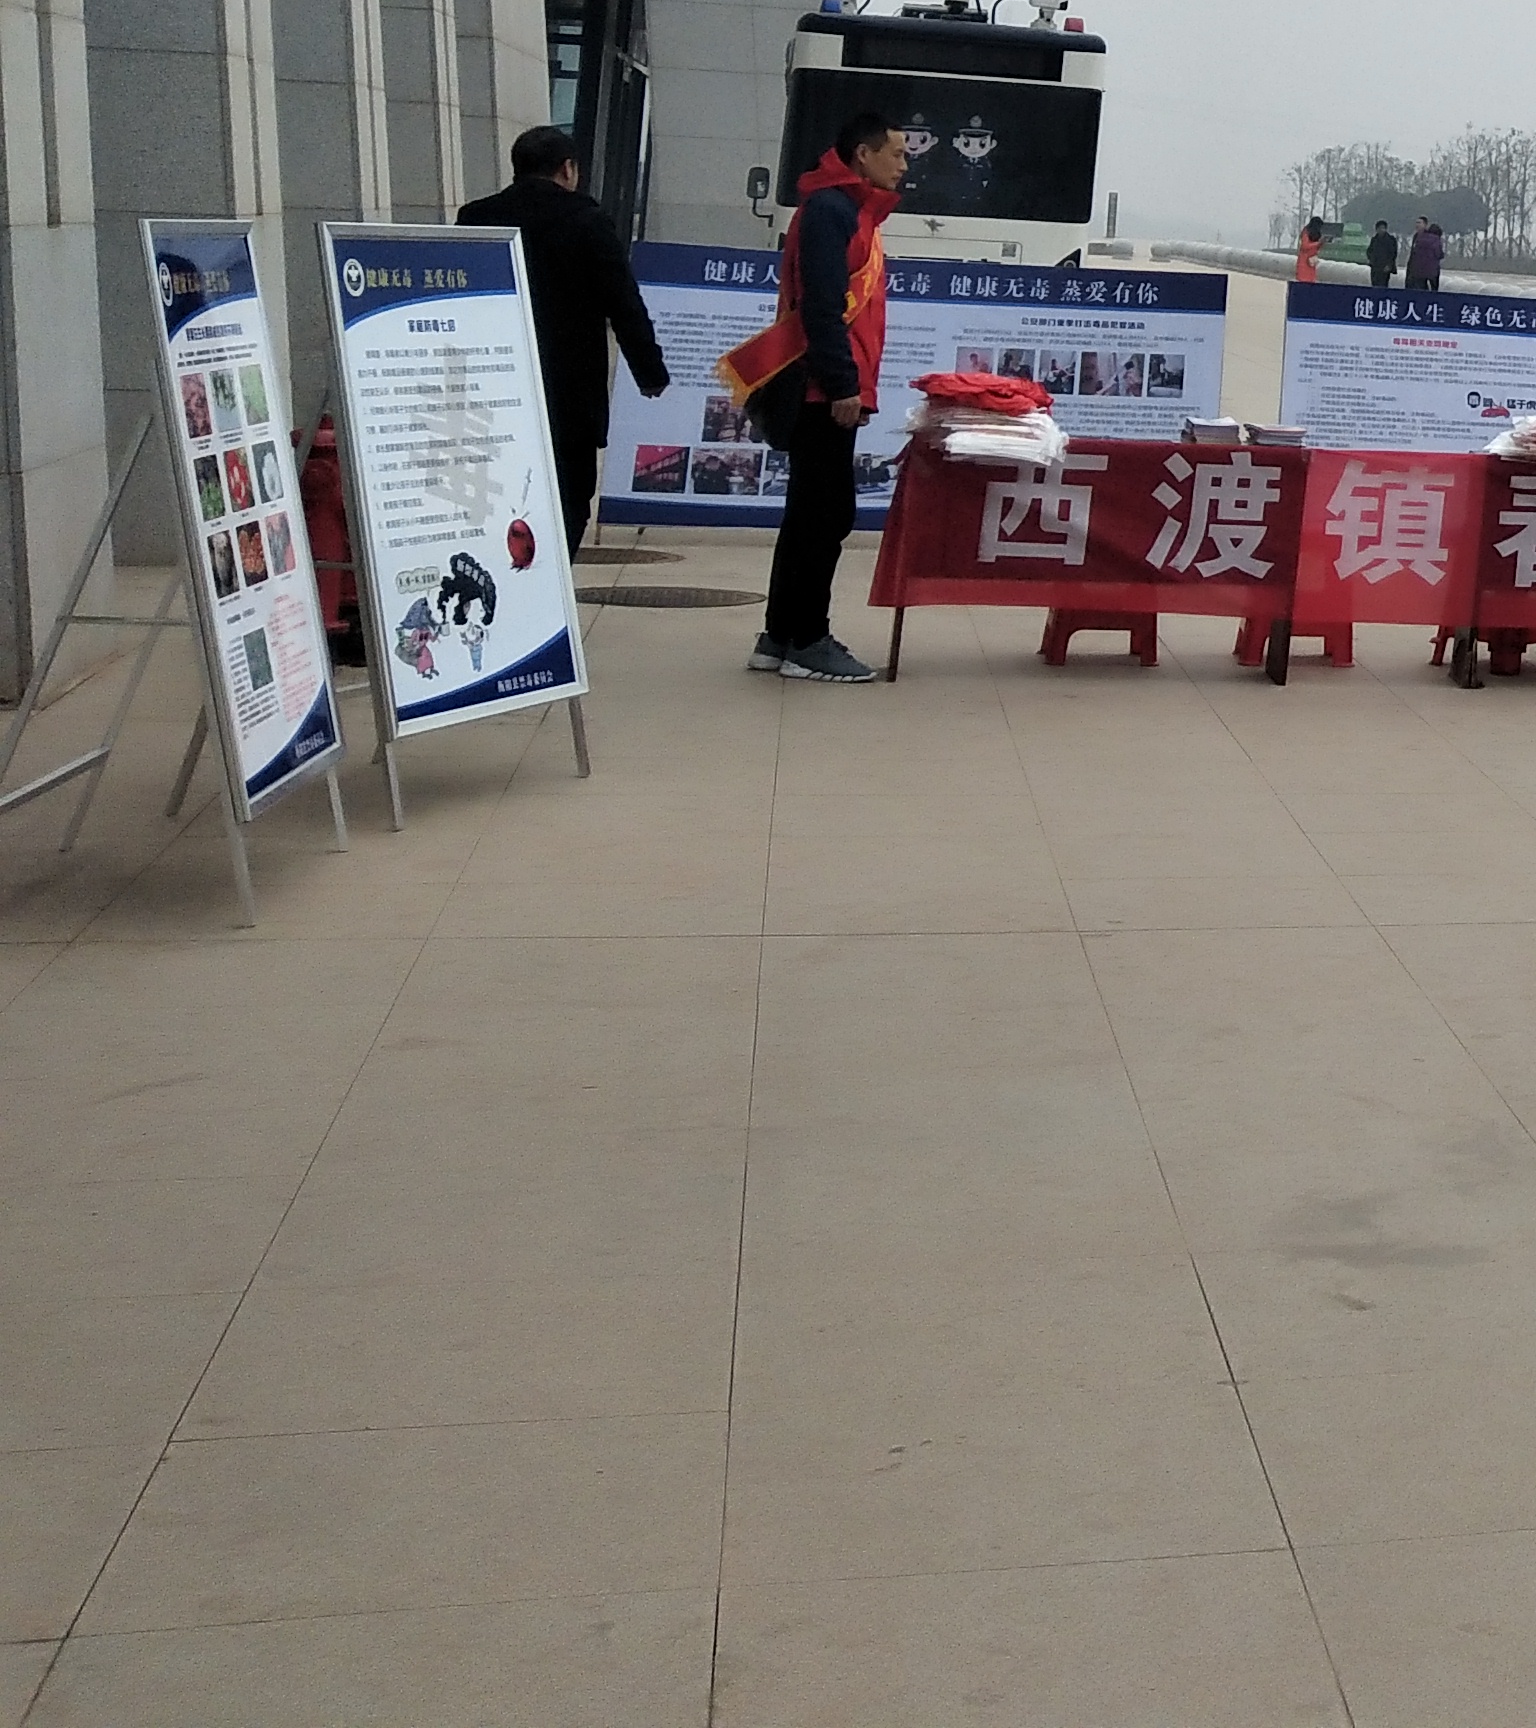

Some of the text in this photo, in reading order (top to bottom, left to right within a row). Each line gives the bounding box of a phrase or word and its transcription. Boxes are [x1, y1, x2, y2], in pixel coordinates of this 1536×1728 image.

[366, 268, 413, 289] 健康无毒
[704, 259, 781, 284] 健康人
[950, 274, 1050, 301] 健康无毒
[1060, 279, 1159, 305] 蒸爱有你
[1353, 297, 1445, 323] 健康人生
